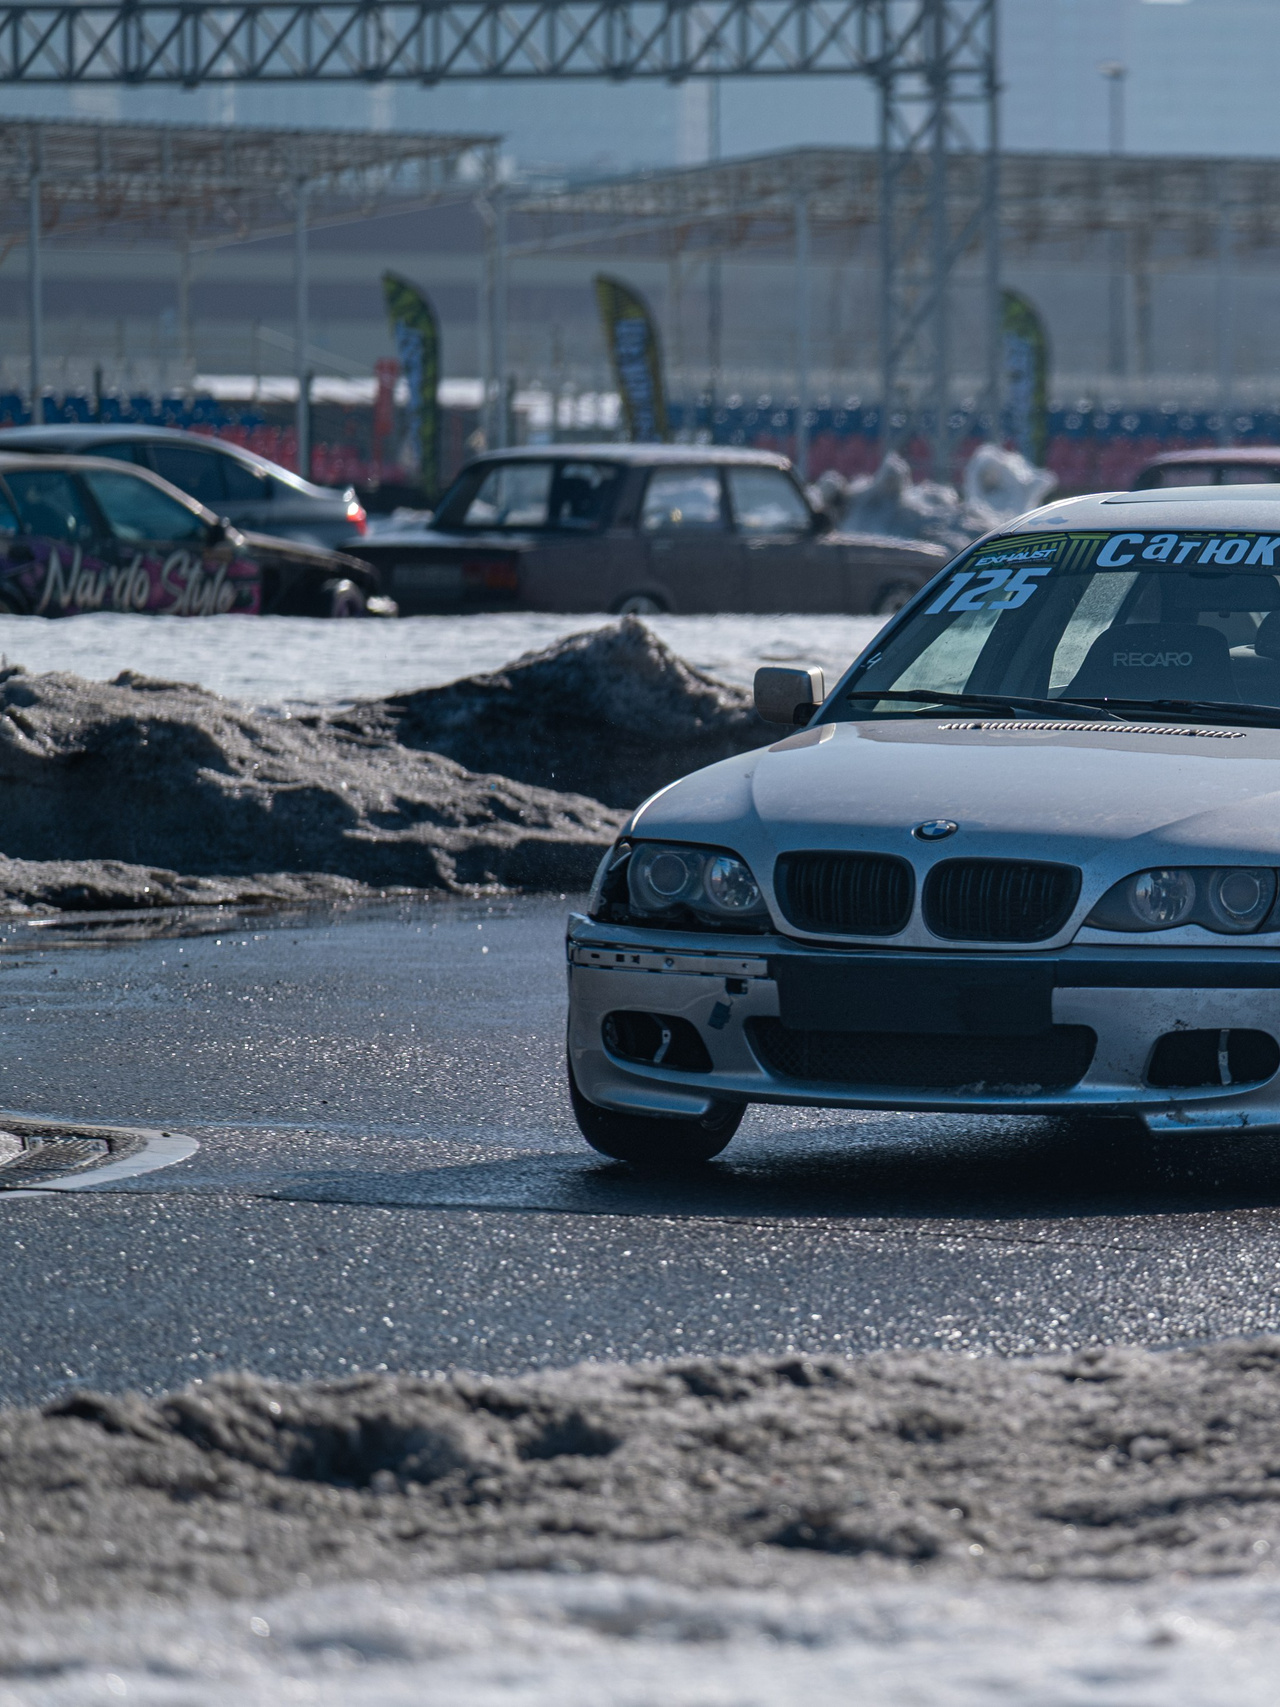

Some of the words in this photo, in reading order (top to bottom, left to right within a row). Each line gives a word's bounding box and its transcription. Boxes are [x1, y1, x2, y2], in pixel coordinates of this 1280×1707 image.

[974, 548, 1057, 567] EXHAUST
[36, 545, 150, 614] Nardo
[924, 567, 1053, 614] 125
[1112, 652, 1193, 667] RECARO
